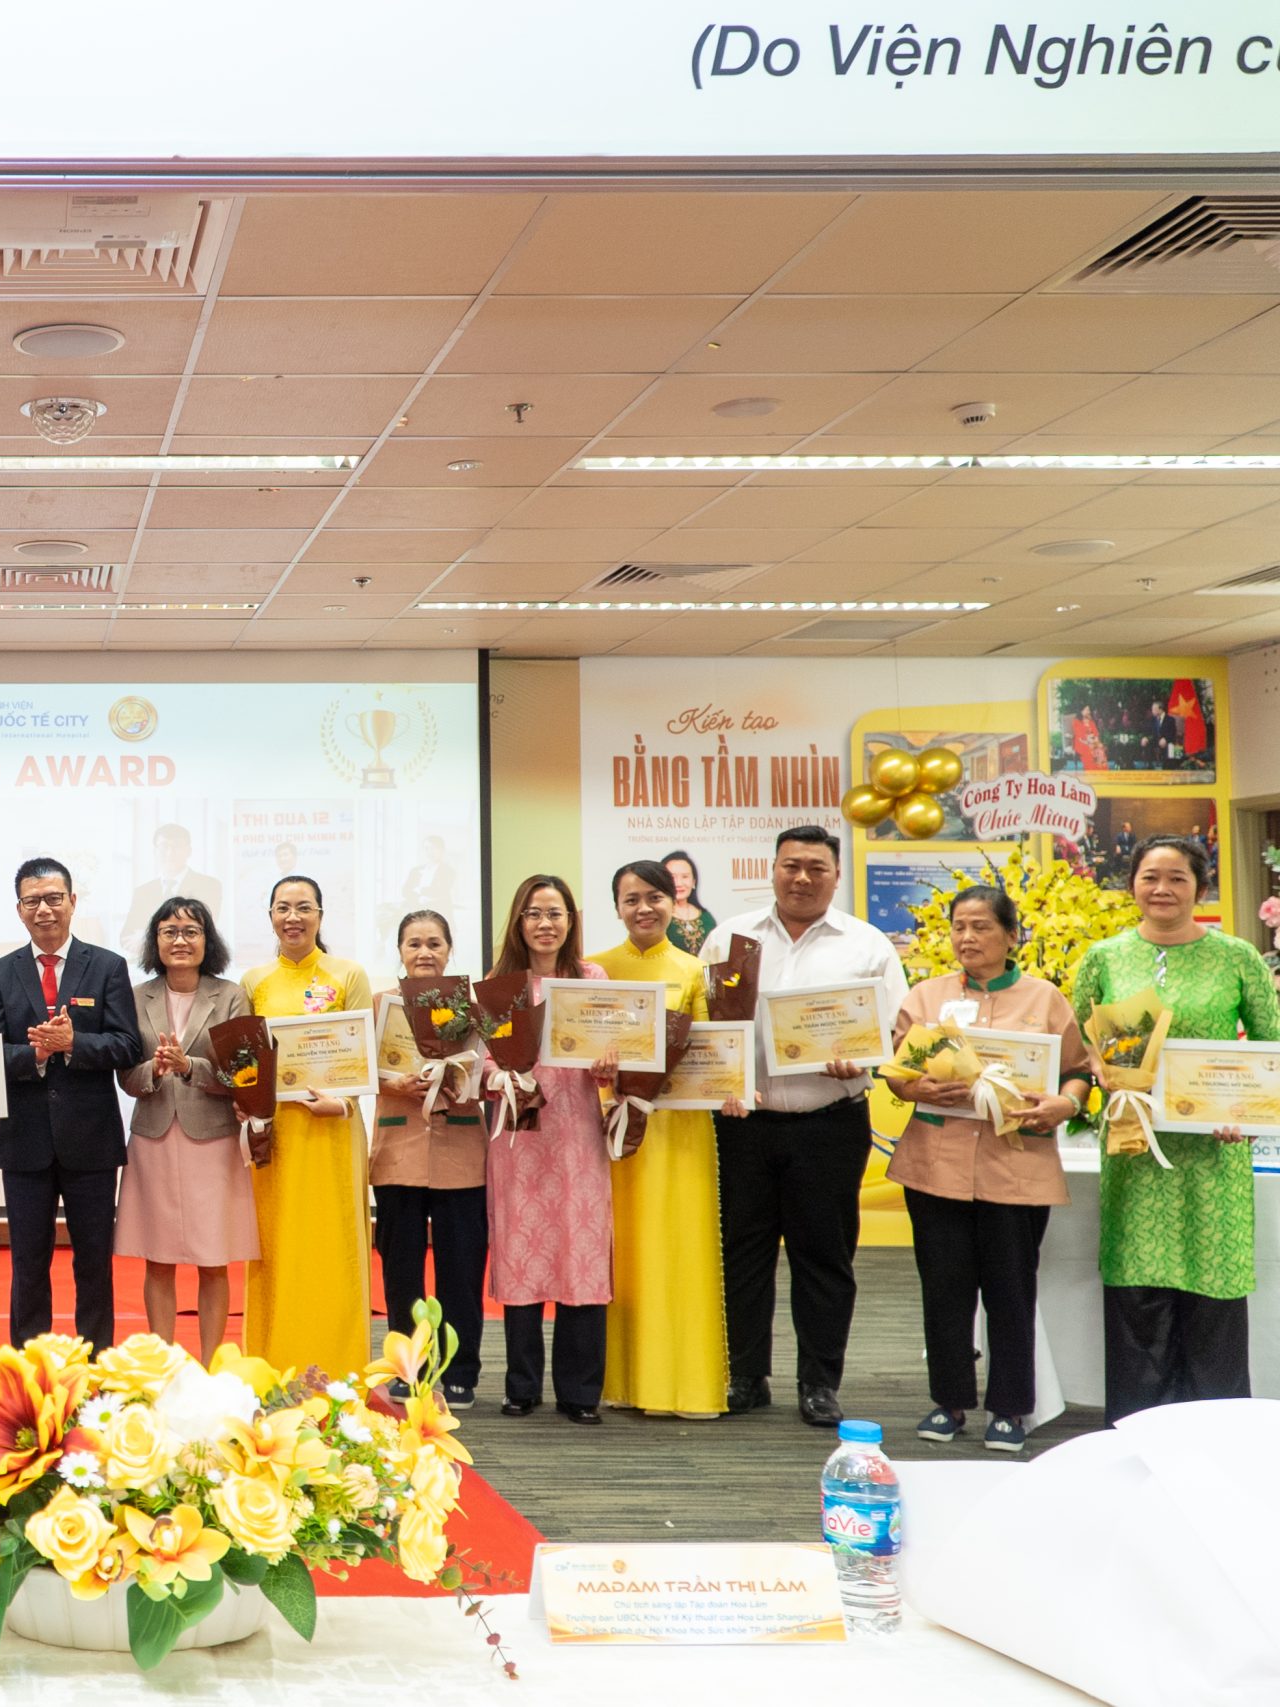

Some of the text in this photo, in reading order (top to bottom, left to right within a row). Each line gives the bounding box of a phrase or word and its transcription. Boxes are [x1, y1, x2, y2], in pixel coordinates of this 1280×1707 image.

[691, 23, 801, 90] (Do
[828, 23, 962, 90] Viện
[984, 23, 1213, 90] Nghiên
[31, 711, 50, 727] TẾ
[54, 714, 89, 727] CITY
[667, 703, 779, 735] Kiến tạo
[14, 755, 176, 788] AWARD
[613, 734, 840, 808] BẰNG TẦM NHÌN
[964, 778, 1091, 808] Công Ty Hoa Lâm
[627, 814, 653, 829] NHÀ
[658, 814, 690, 829] SÁNG
[694, 814, 717, 832] LẬP
[722, 814, 744, 832] TẬP
[749, 814, 782, 829] ĐOÀN
[978, 804, 1080, 836] Chúc Mừng
[733, 858, 768, 880] MADAM
[577, 1574, 807, 1595] MADAM TRẦN THỊ LÂM
